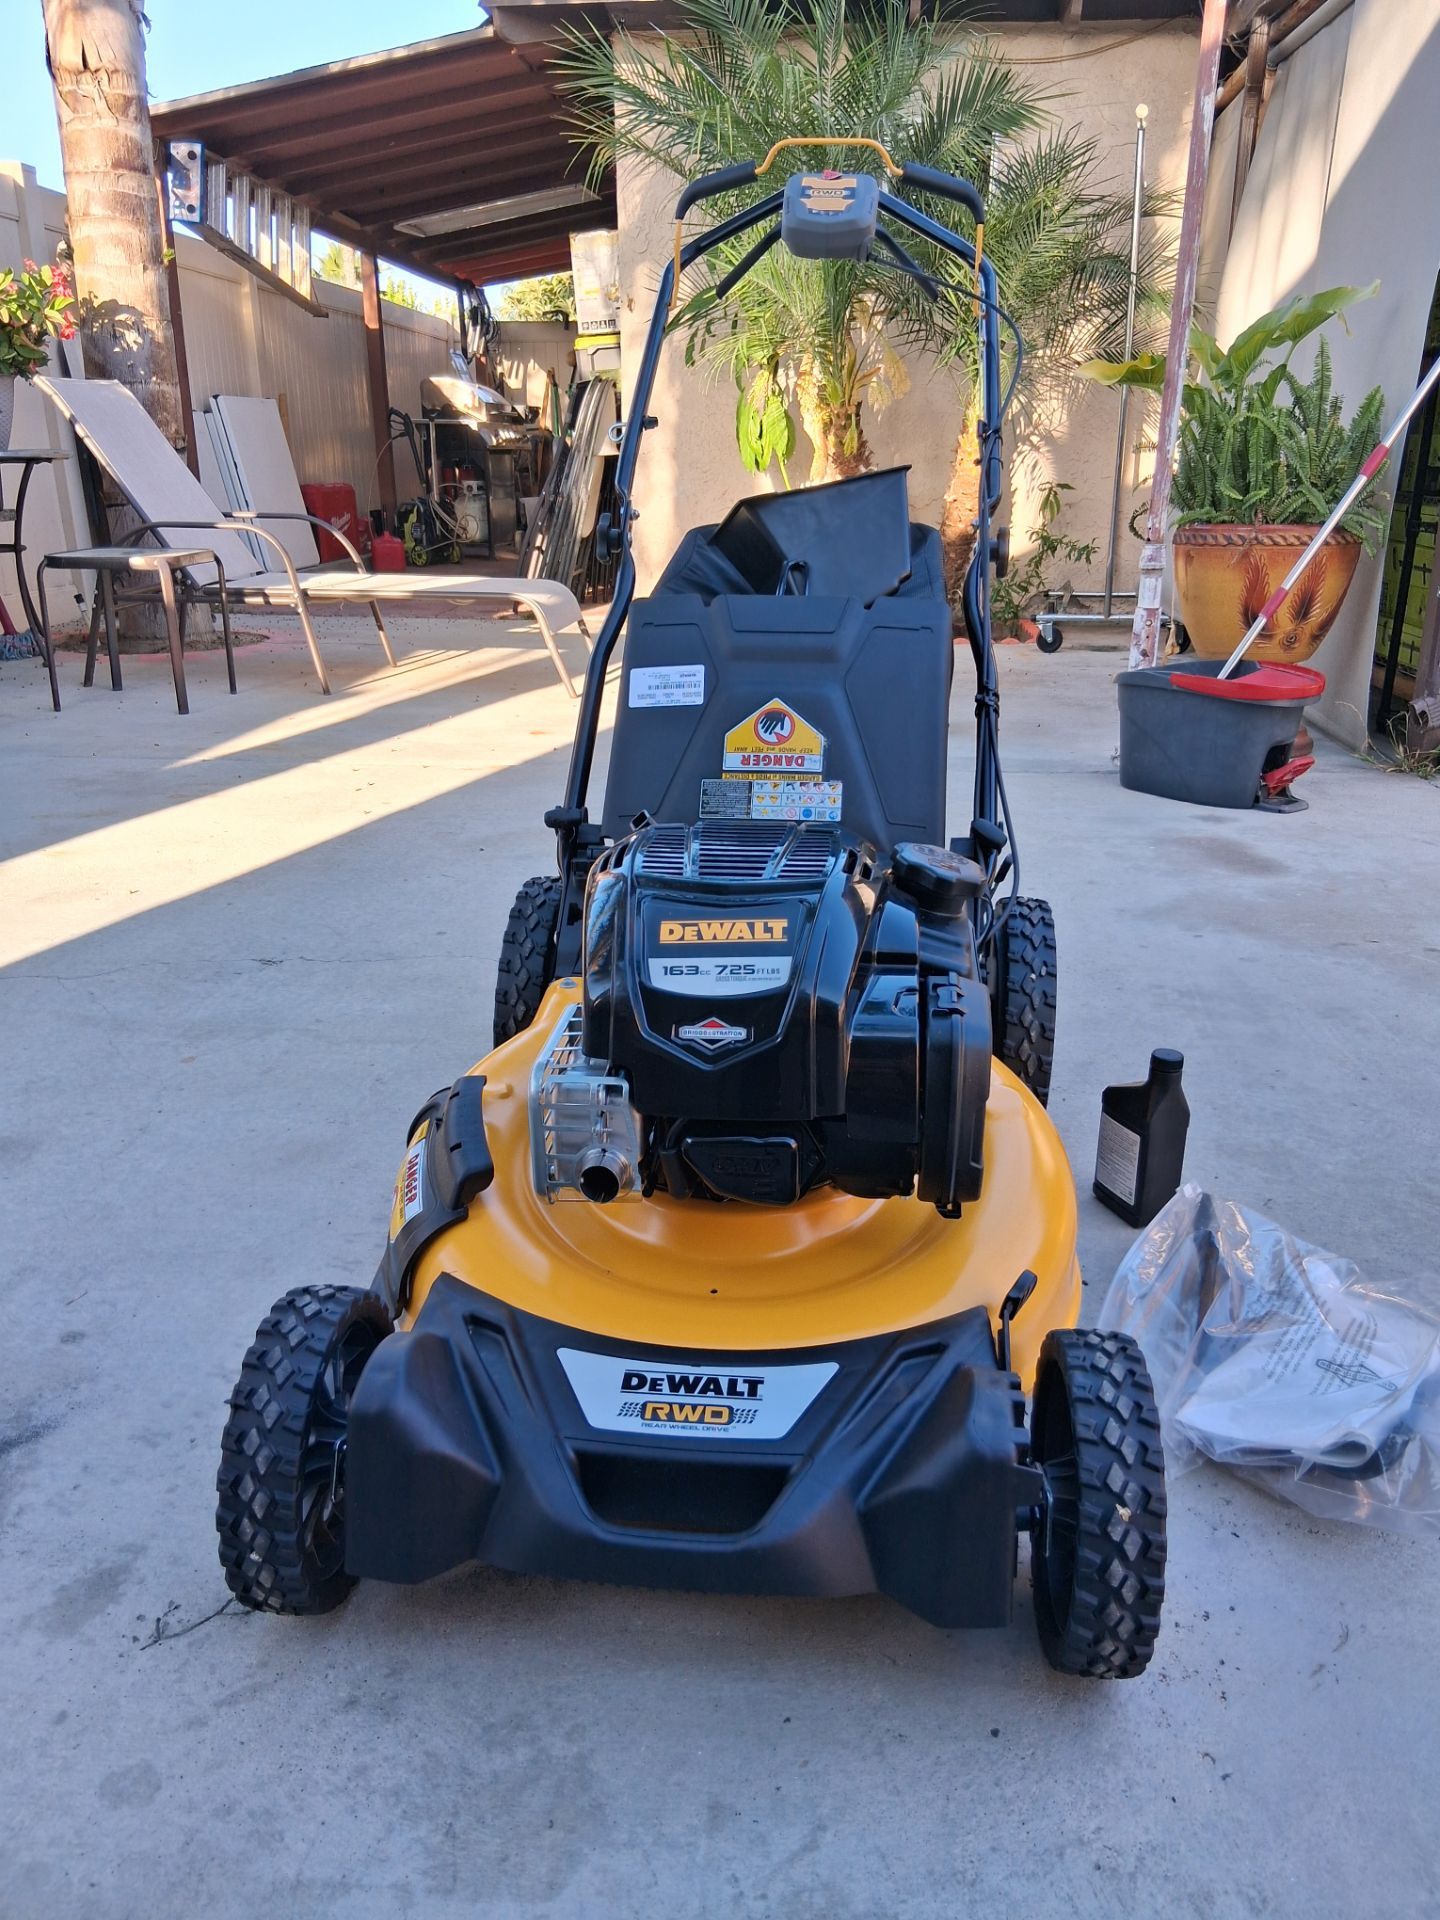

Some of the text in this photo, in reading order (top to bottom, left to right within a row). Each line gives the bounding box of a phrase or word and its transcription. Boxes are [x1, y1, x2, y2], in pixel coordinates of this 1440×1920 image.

[740, 754, 805, 767] DANGER
[659, 919, 788, 944] DEWALT
[714, 964, 756, 976] 7.25
[405, 1154, 419, 1206] DANGER
[620, 1369, 765, 1401] DEWALT
[644, 1402, 730, 1424] RWD
[669, 1423, 700, 1431] WHEEL
